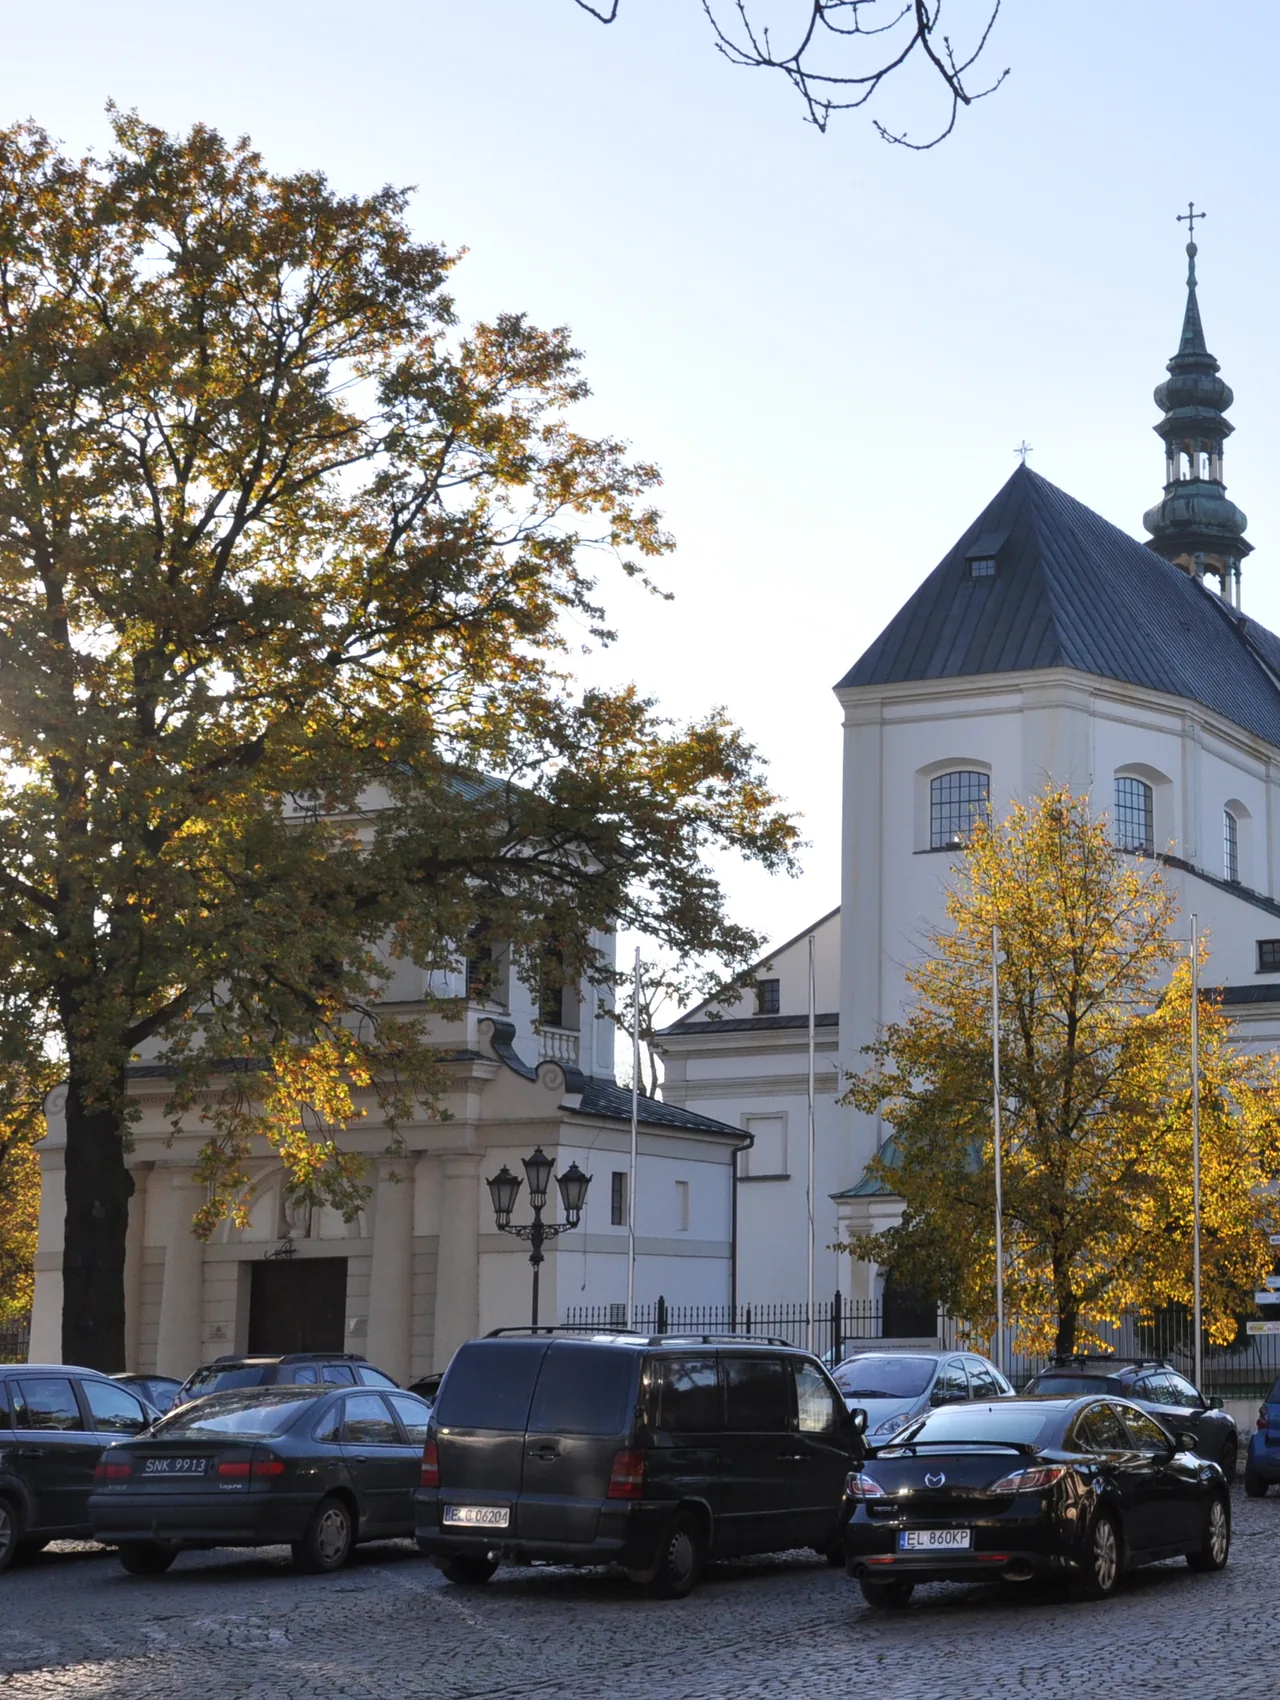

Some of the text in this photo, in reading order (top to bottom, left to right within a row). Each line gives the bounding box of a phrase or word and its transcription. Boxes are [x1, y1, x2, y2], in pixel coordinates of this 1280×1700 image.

[145, 1459, 206, 1472] SNK 9913
[475, 1509, 509, 1524] 06204
[907, 1531, 969, 1546] EL 860KP
